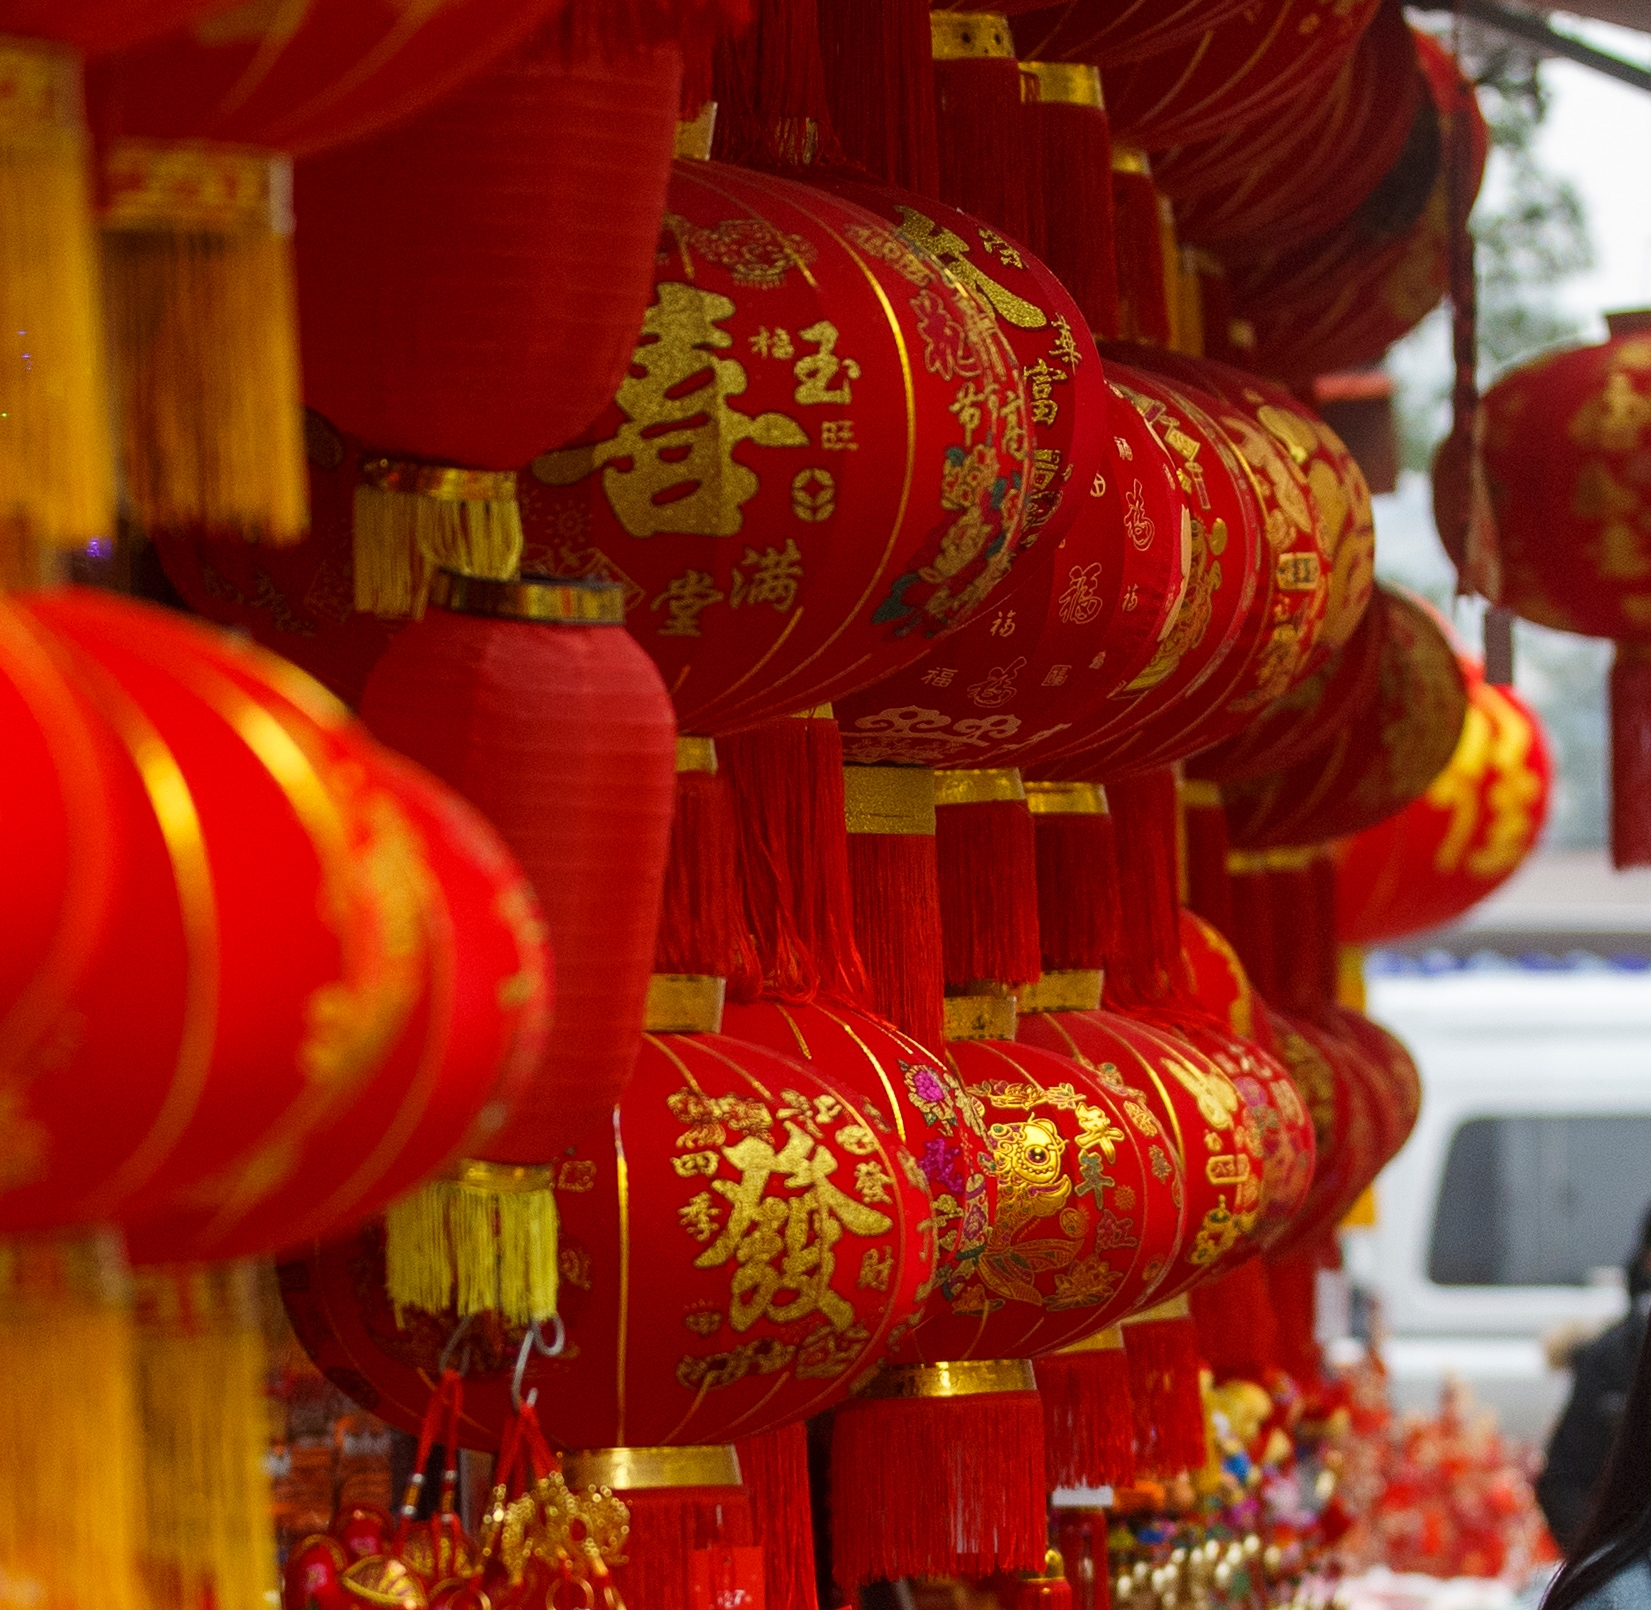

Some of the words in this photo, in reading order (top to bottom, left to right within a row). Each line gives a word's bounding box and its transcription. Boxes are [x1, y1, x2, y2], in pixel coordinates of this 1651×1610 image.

[793, 320, 862, 405] 玉
[1023, 357, 1068, 426] 富
[649, 568, 725, 637] 堂
[990, 609, 1017, 638] 福
[920, 666, 959, 688] 福
